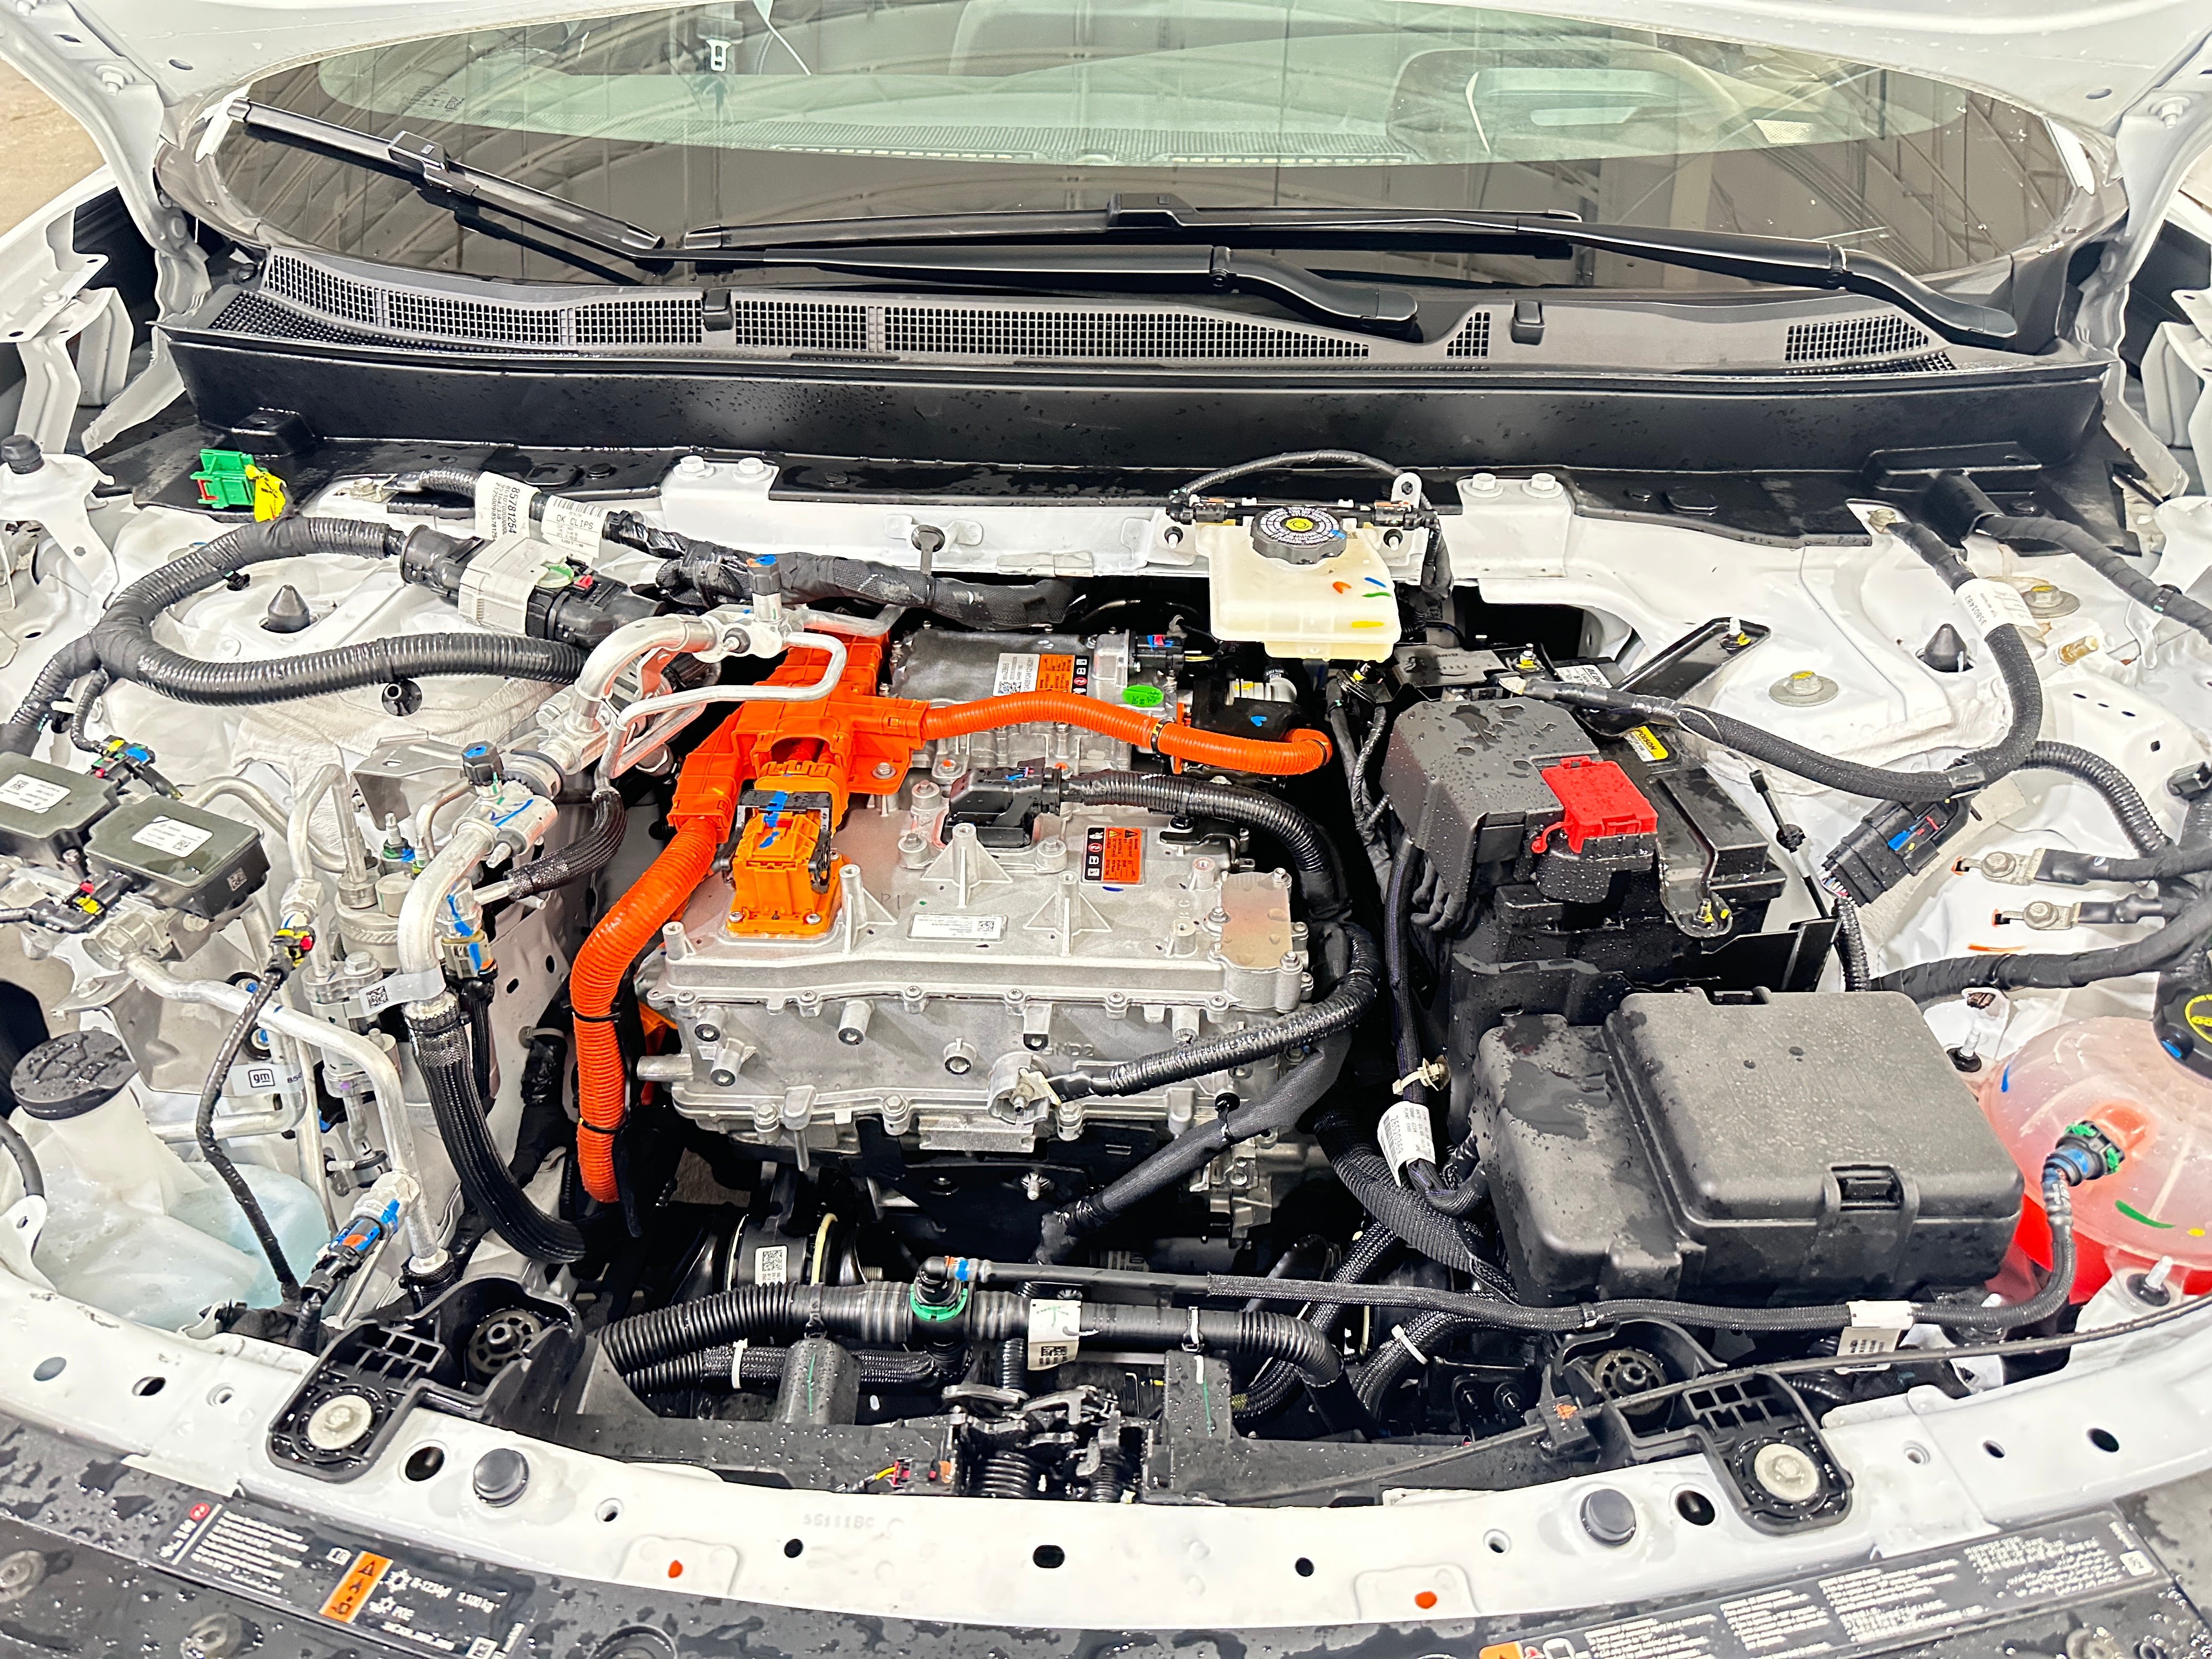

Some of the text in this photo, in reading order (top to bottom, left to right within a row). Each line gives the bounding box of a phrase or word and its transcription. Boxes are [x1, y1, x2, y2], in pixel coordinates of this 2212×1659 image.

[507, 487, 521, 534] 85781254
[556, 514, 566, 523] OK
[570, 517, 594, 530] CLIPS
[253, 1073, 271, 1084] gm
[1391, 1115, 1404, 1154] 26520369
